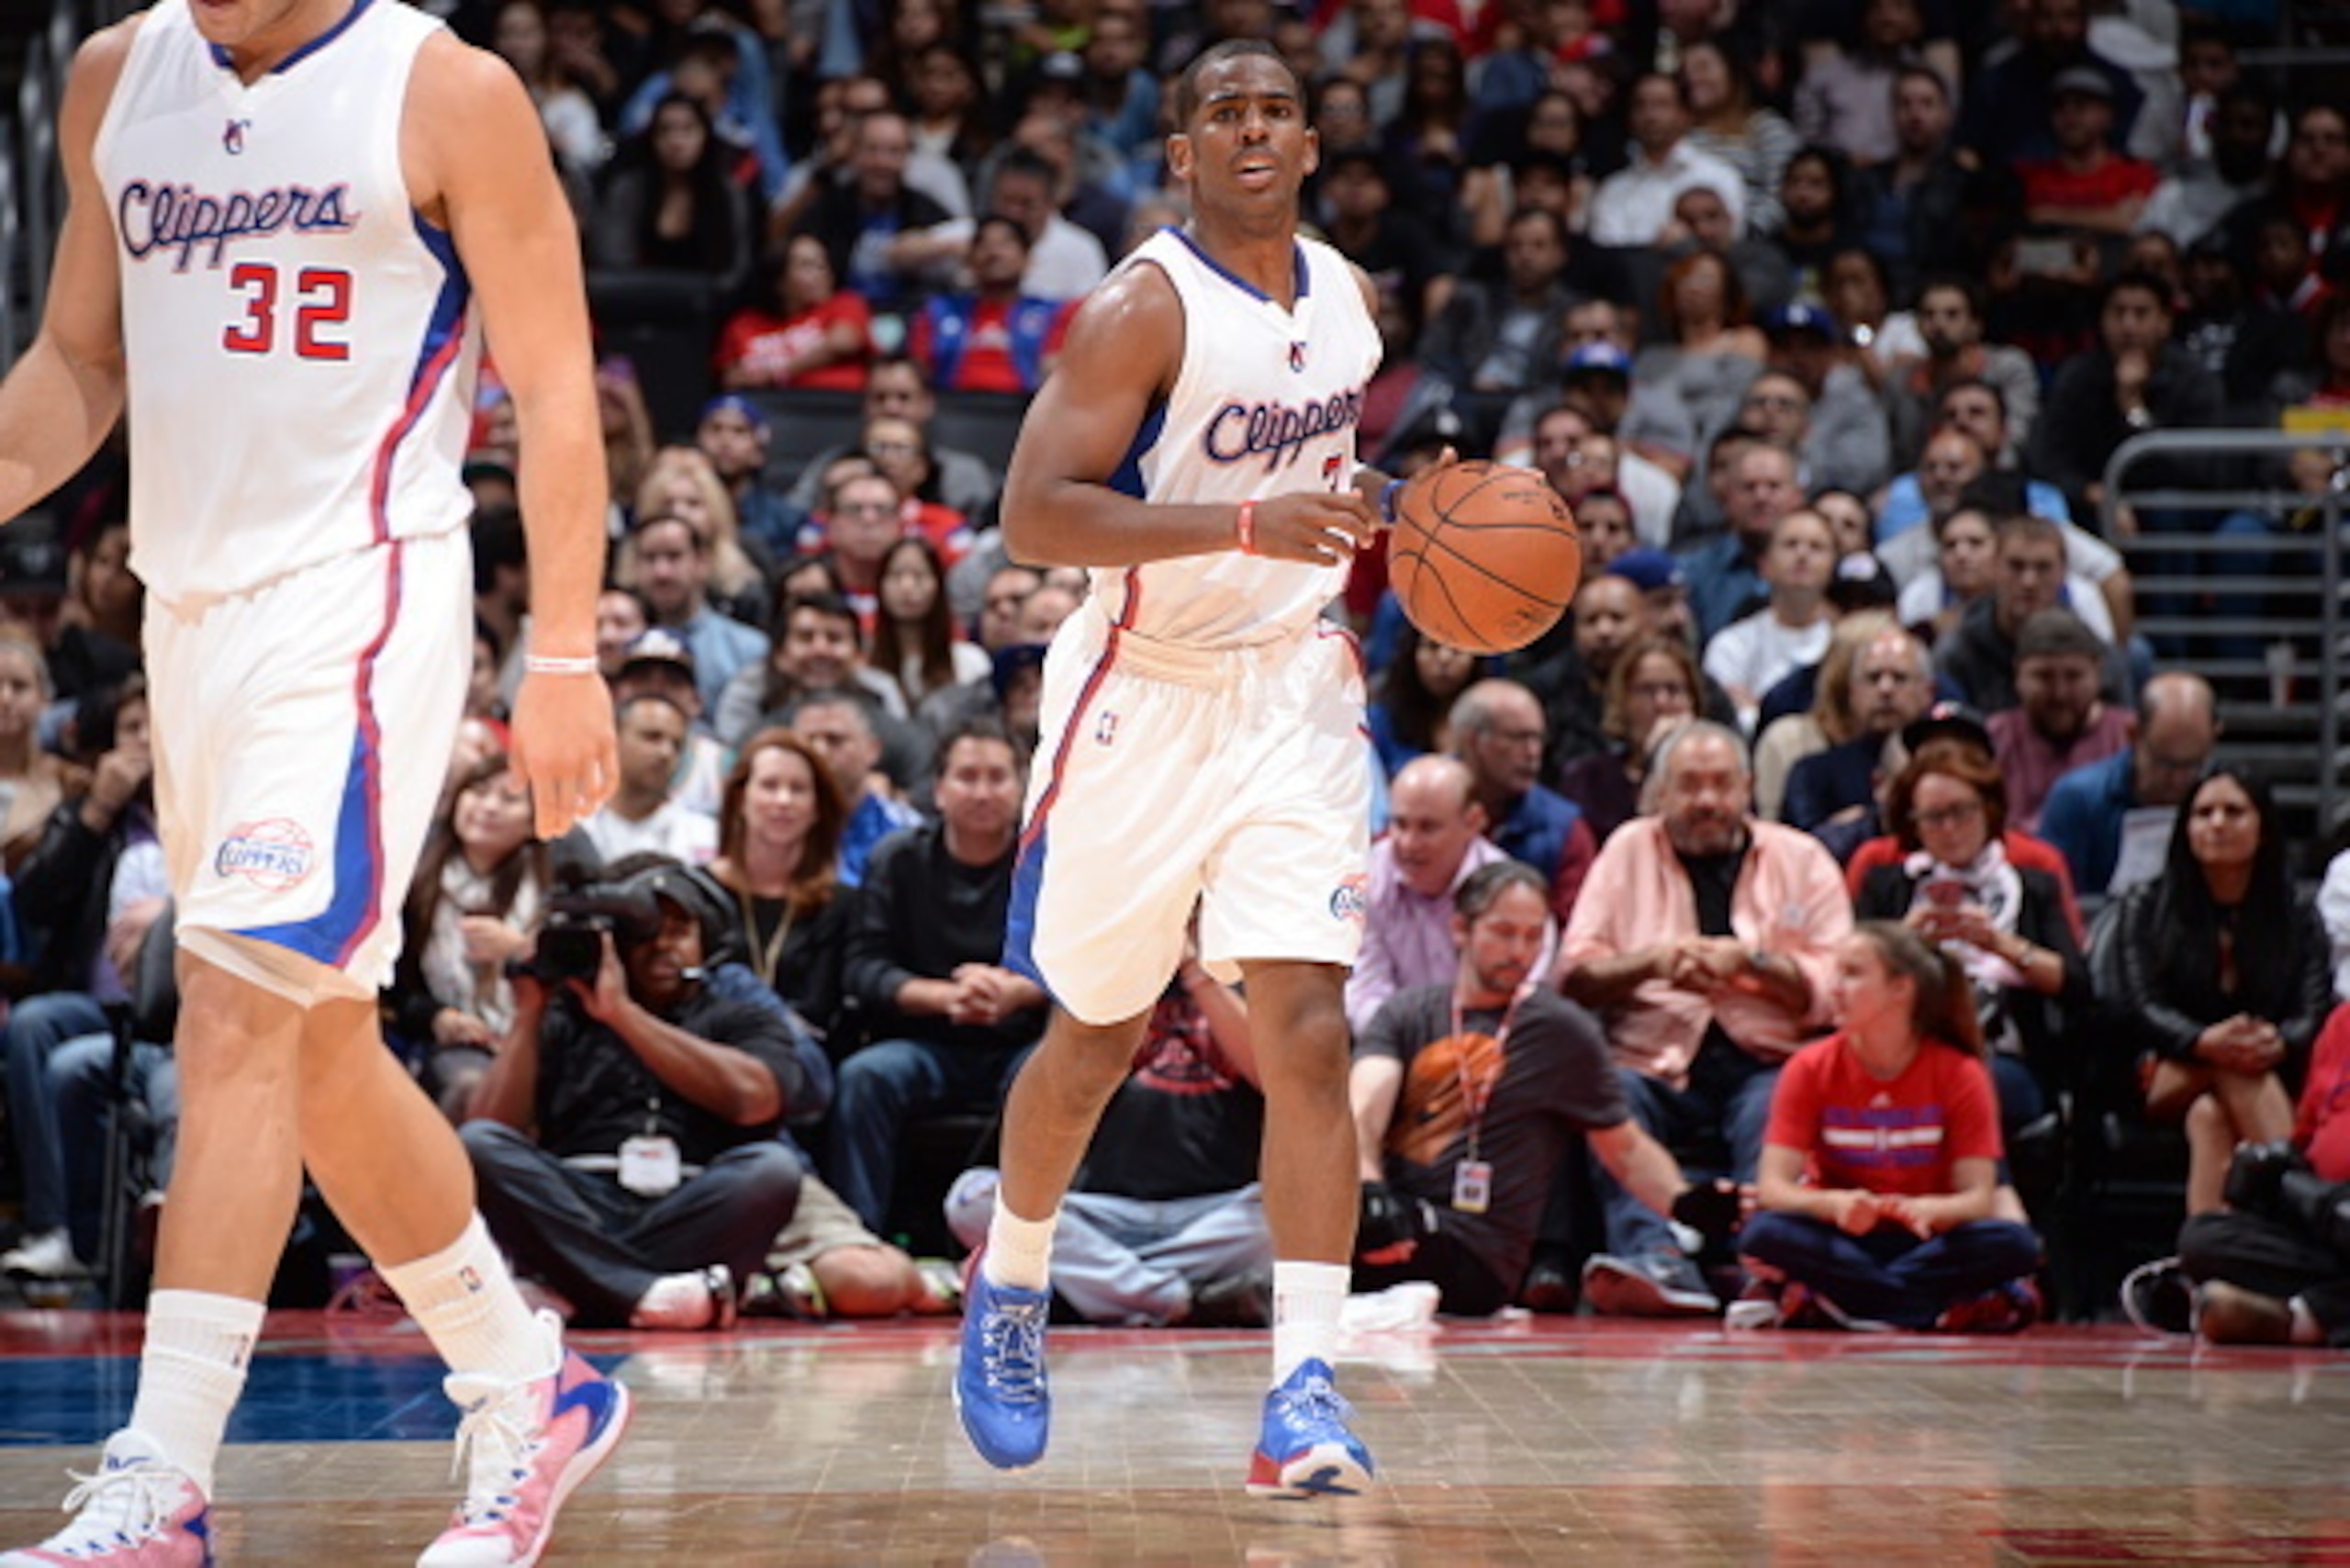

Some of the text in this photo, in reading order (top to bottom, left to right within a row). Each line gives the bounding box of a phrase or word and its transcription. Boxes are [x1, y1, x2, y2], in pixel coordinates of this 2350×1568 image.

[120, 179, 359, 274] Clippers
[223, 261, 352, 361] 32
[1202, 389, 1360, 475] Clipper
